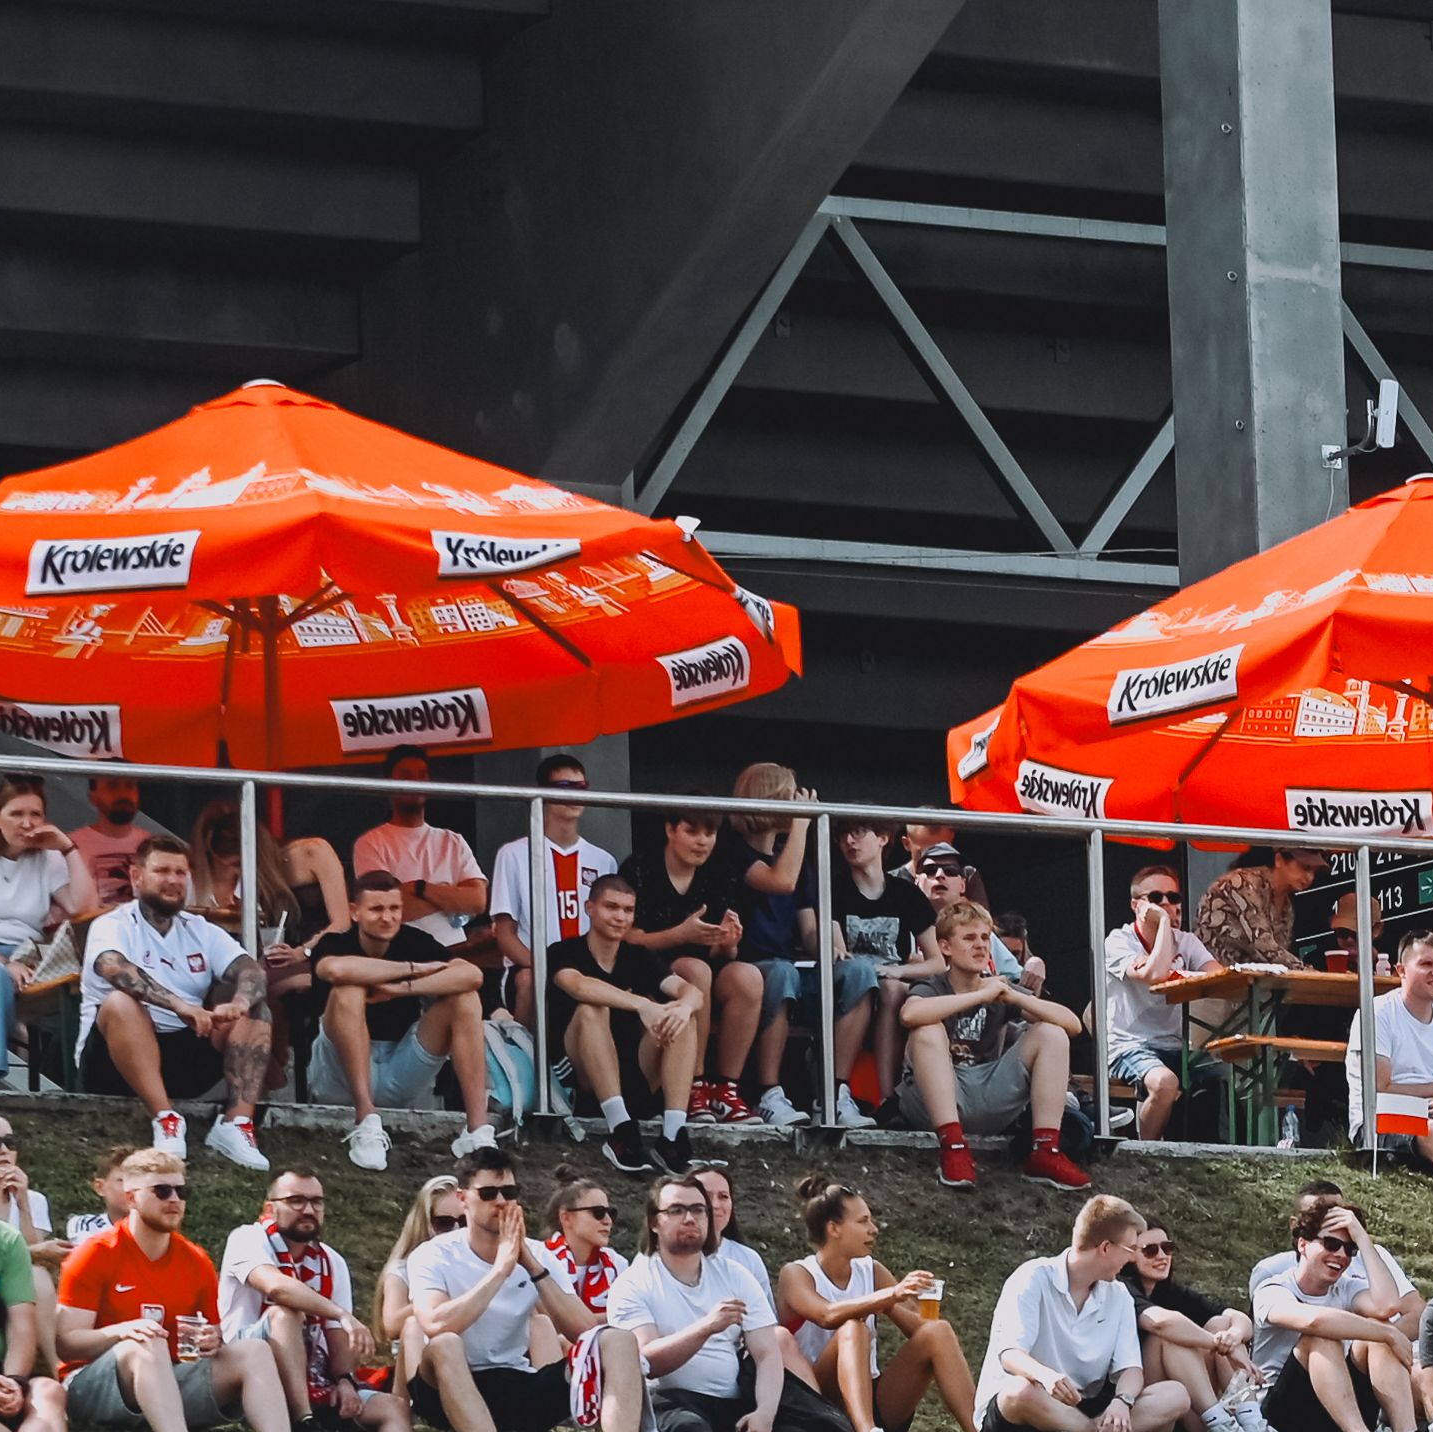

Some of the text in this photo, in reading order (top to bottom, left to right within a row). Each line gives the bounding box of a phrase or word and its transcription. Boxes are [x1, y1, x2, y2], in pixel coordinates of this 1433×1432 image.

[41, 540, 184, 585] Królewskie
[1118, 655, 1231, 712] Królewskie
[558, 890, 579, 920] 15
